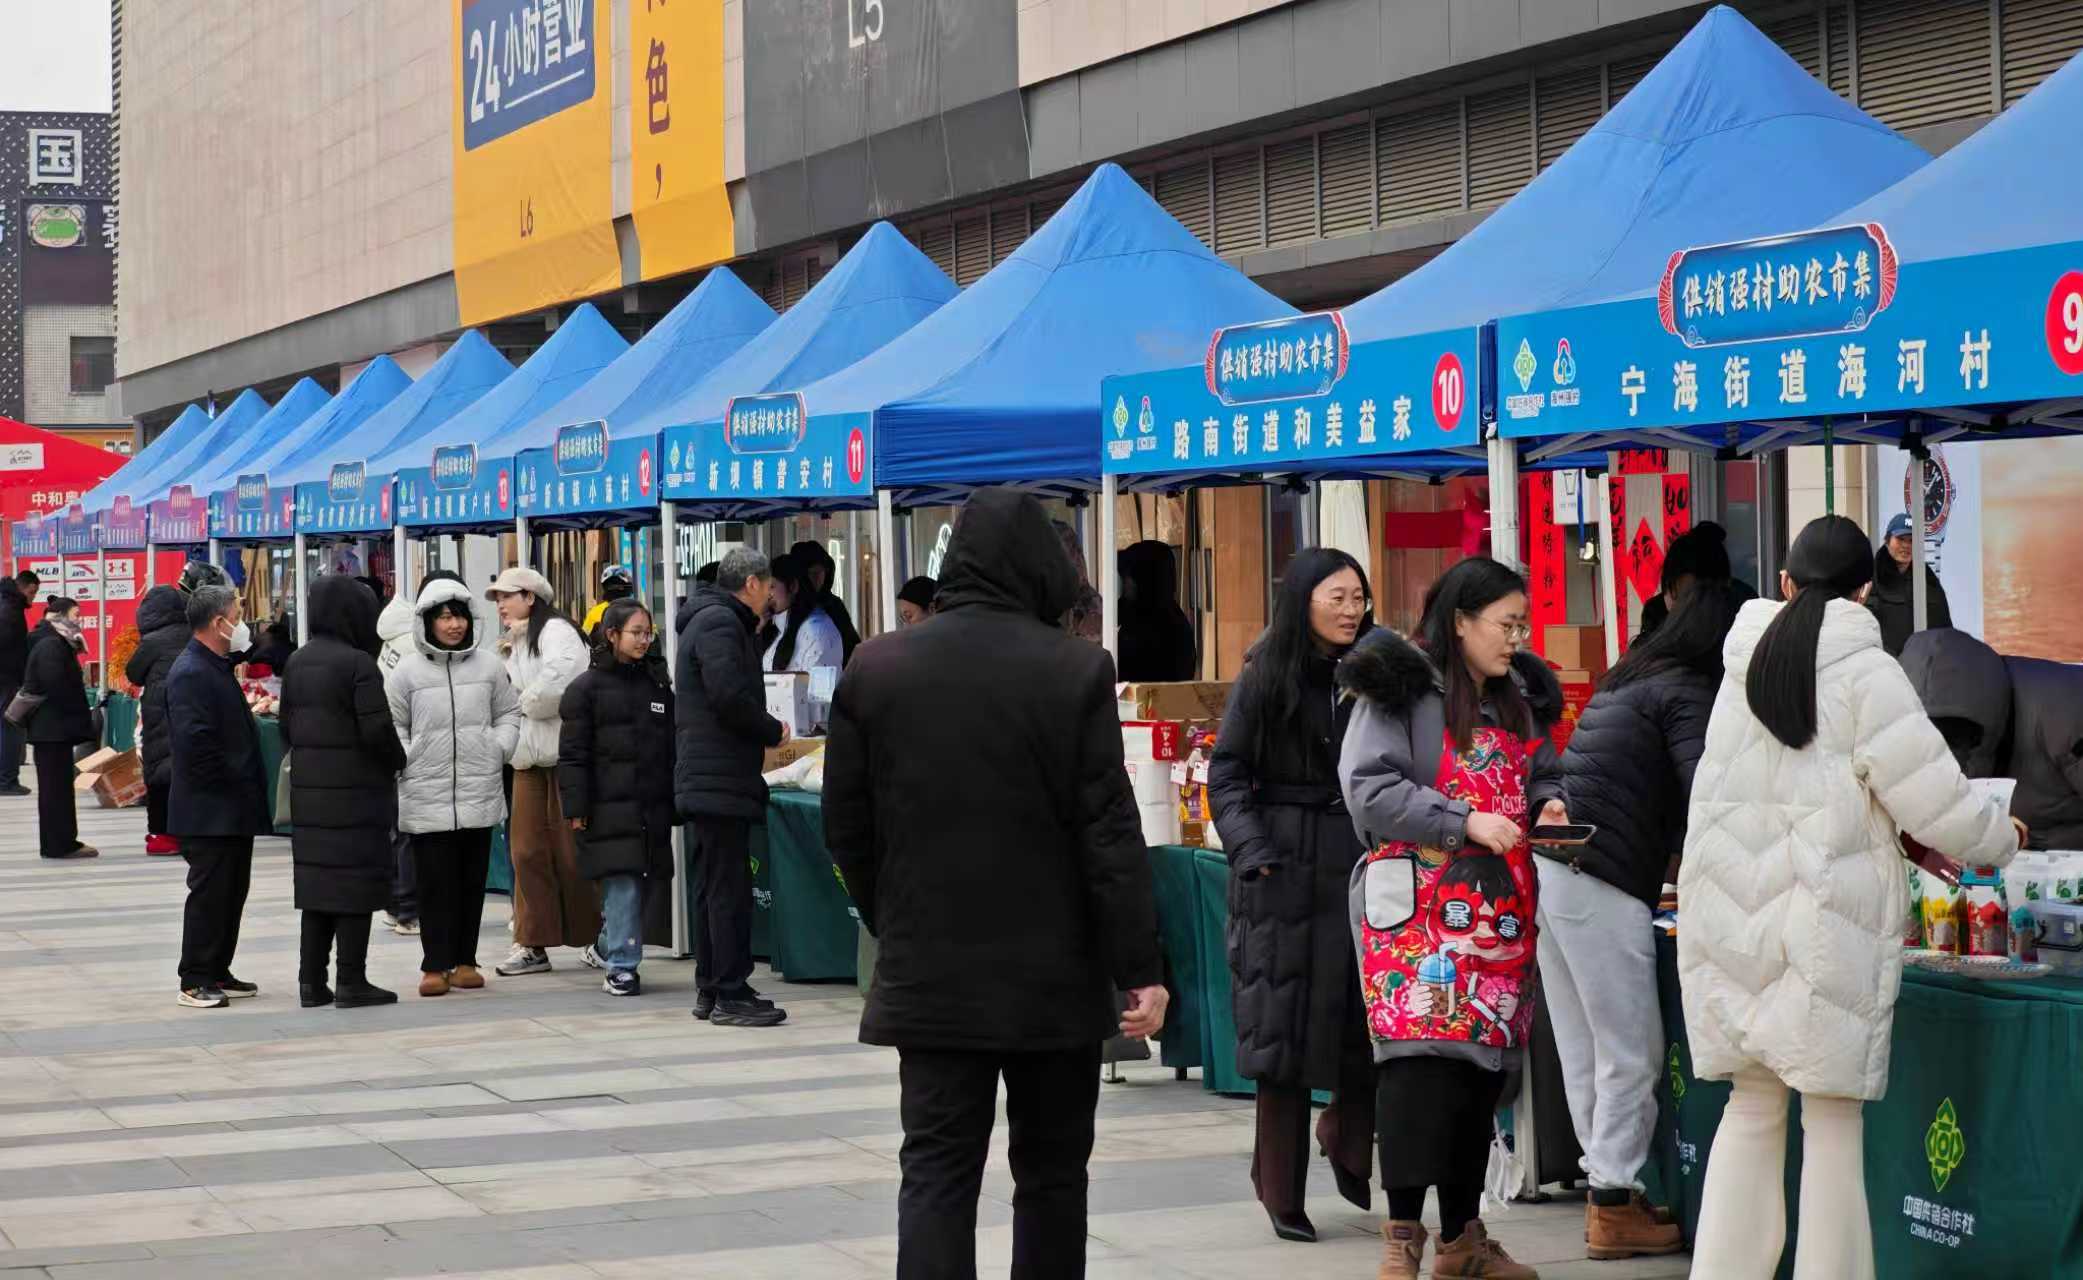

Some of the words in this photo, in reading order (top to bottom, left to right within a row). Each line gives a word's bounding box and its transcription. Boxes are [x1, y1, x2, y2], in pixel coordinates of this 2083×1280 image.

[848, 0, 884, 48] L5
[520, 197, 534, 238] L6
[1681, 249, 1873, 318] 供销强村助农市集
[2063, 289, 2083, 352] 9
[1220, 333, 1334, 382] 供销强村助农市集
[1621, 328, 1992, 417] 宁海街道海河村
[1438, 367, 1460, 415] 10
[1173, 395, 1412, 460] 路南街道和美益家
[641, 459, 650, 488] 12
[851, 439, 862, 473] 11
[36, 567, 59, 576] MLB
[1903, 1195, 1976, 1236] 中国供销合作社
[1910, 1222, 1933, 1241] CHINA
[1933, 1229, 1961, 1249] CO-OP
